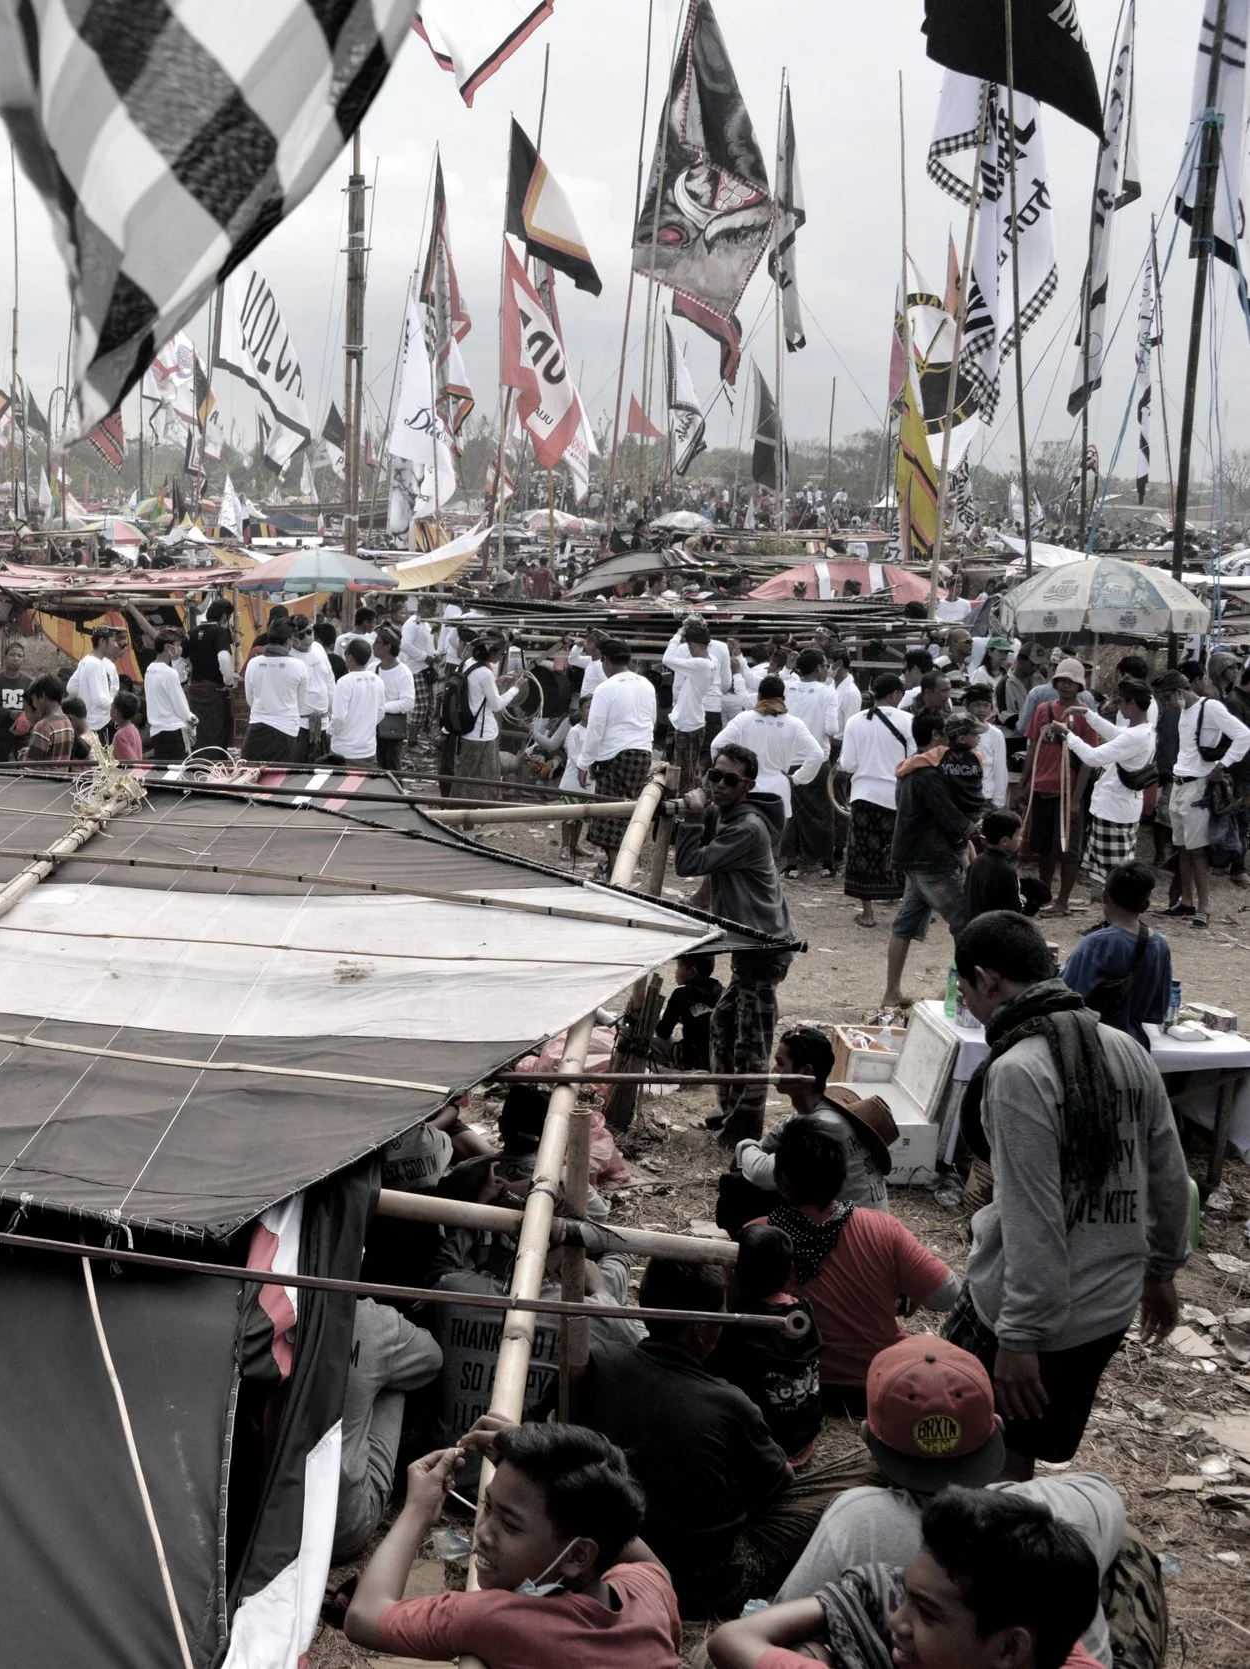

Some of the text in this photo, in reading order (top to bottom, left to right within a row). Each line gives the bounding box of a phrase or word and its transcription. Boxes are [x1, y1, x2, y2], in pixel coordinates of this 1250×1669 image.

[941, 763, 979, 777] YMCA
[1104, 1190, 1138, 1224] KITE
[450, 1318, 502, 1352] THANK
[460, 1361, 484, 1391] SO
